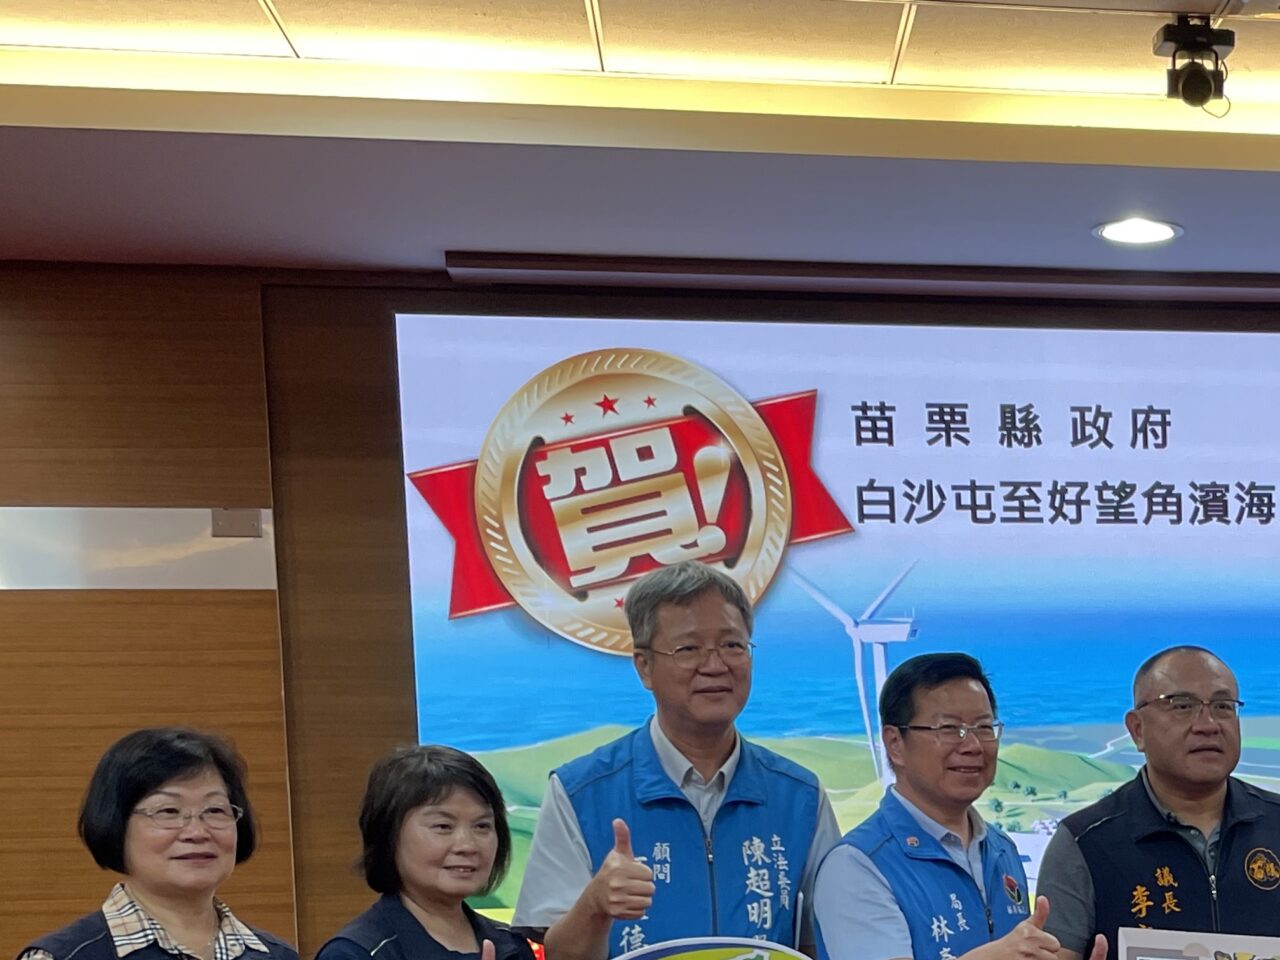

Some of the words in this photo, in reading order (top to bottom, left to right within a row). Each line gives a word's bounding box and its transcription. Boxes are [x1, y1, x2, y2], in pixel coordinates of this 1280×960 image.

[850, 400, 1172, 450] 苗栗縣政府
[652, 842, 672, 884] 顧問
[742, 836, 774, 930] 陳超明
[771, 833, 792, 911] 立法委員
[949, 893, 971, 931] 局長
[1154, 866, 1181, 914] 議長
